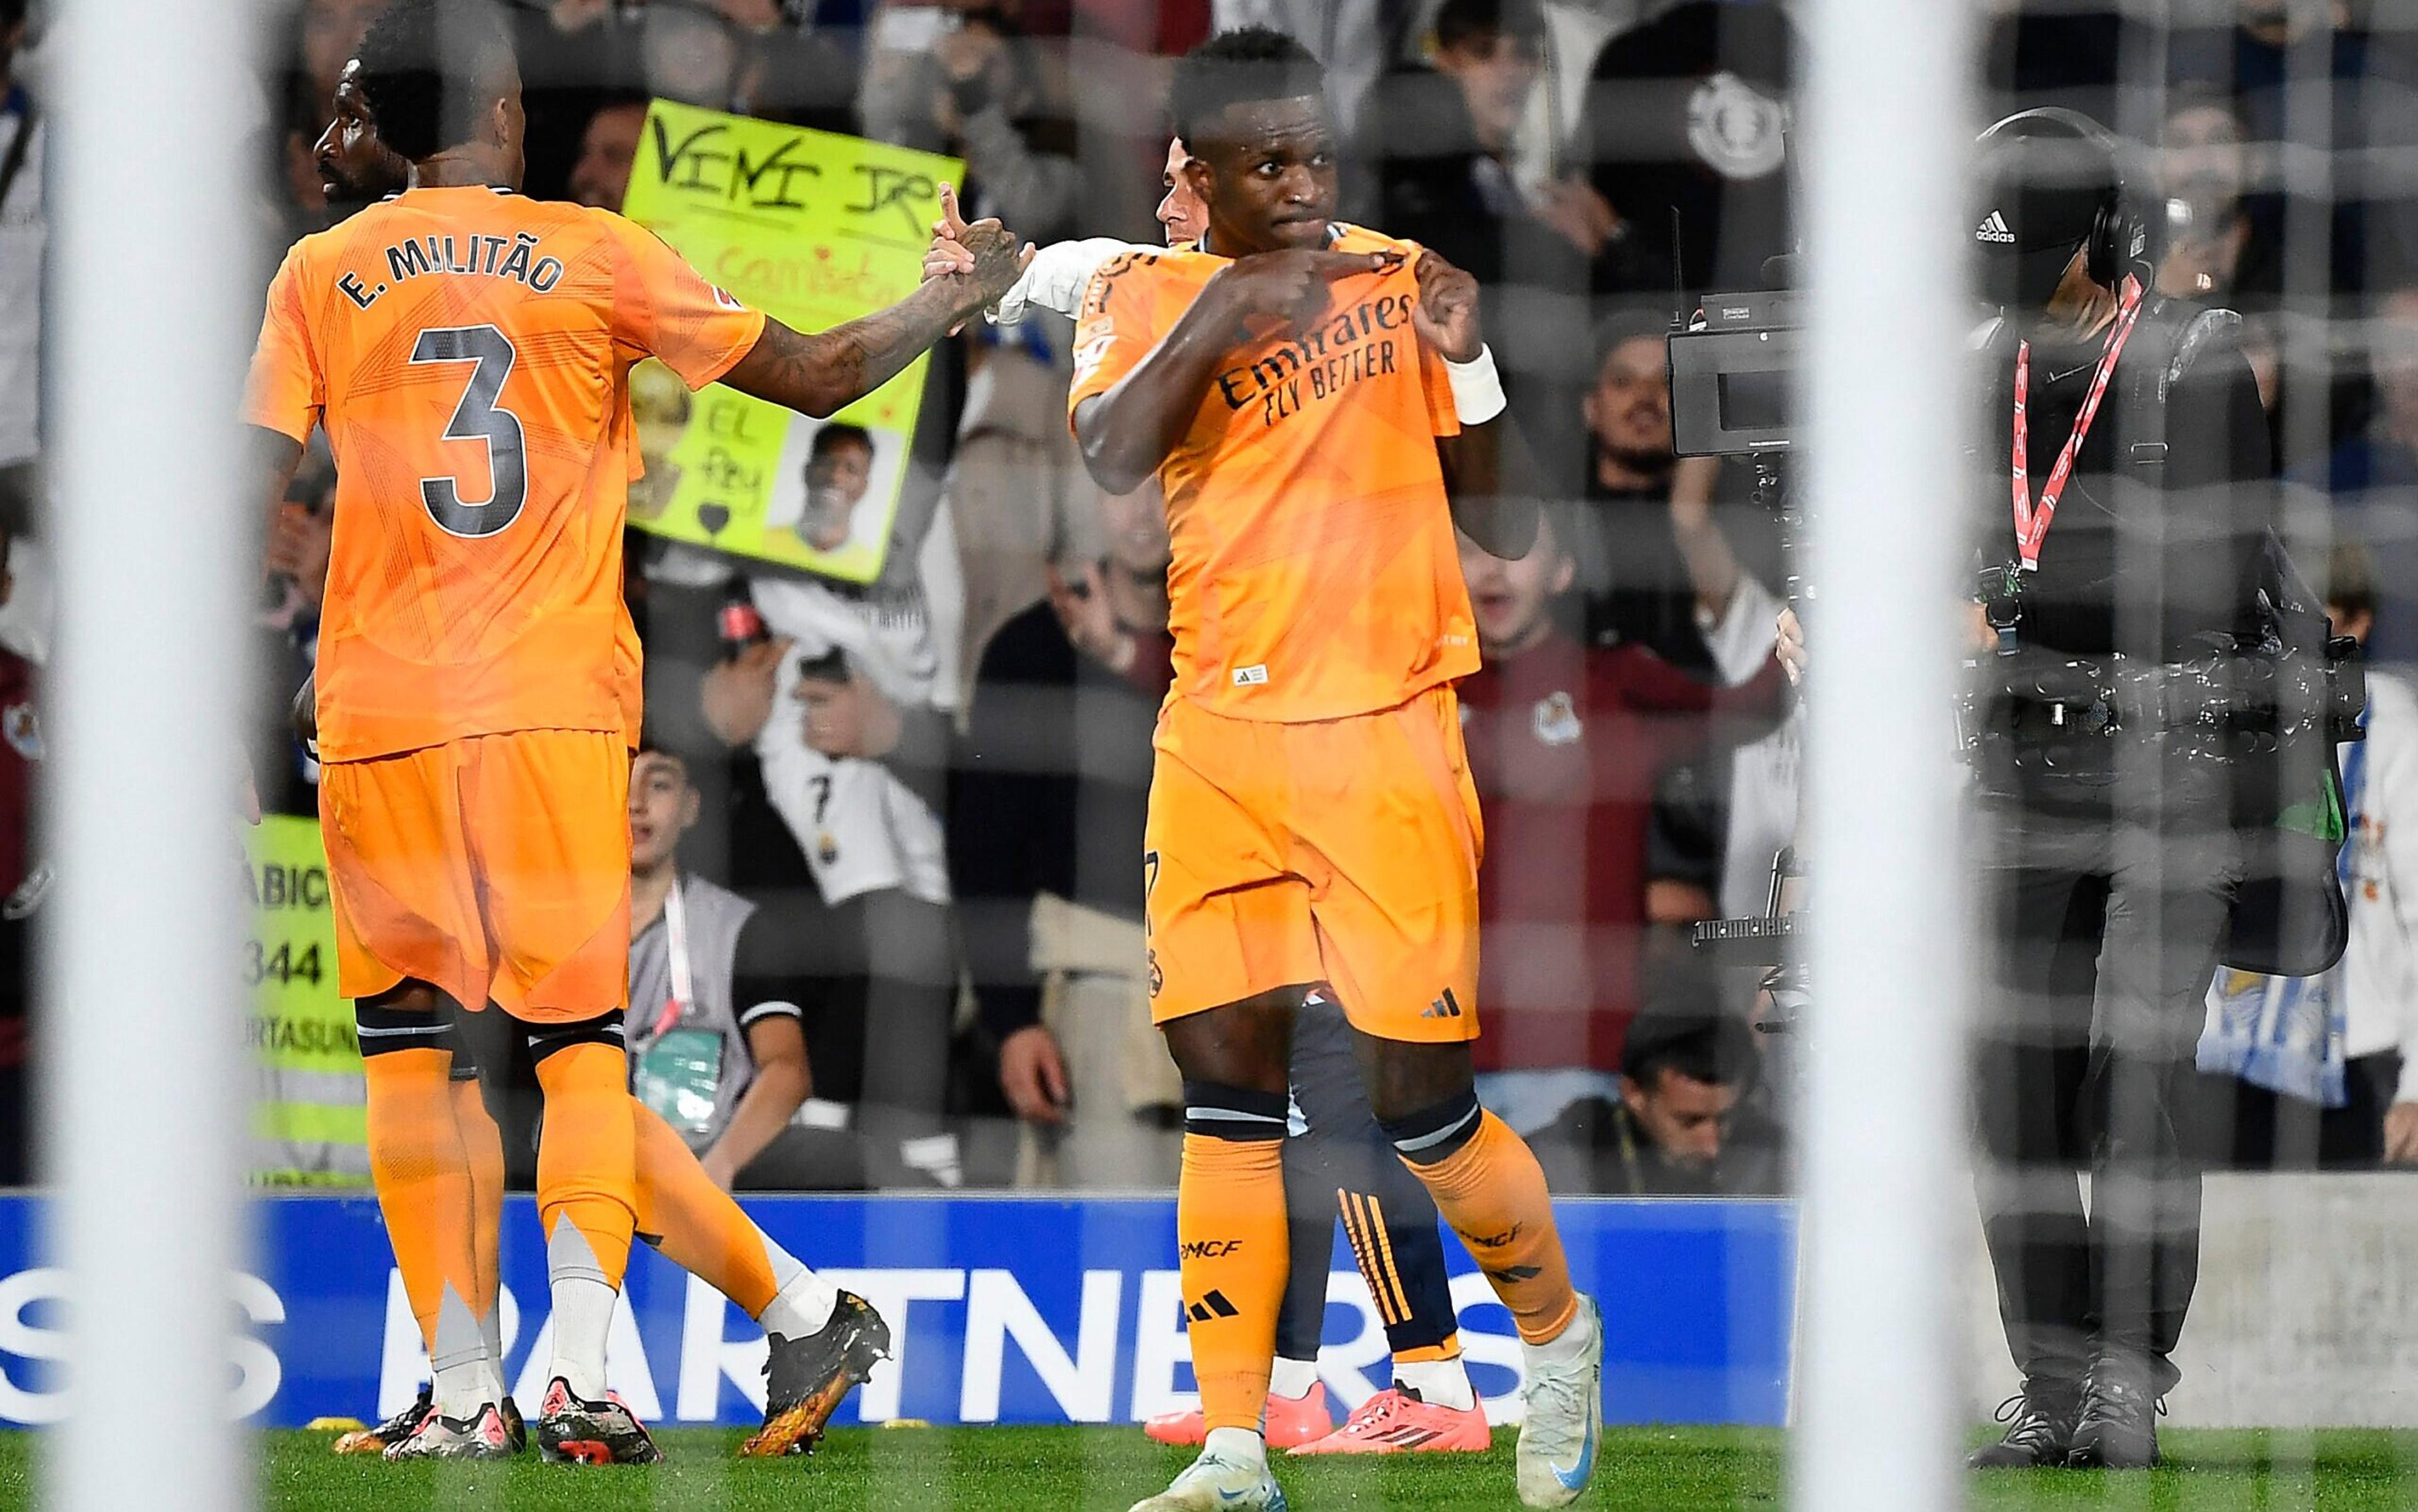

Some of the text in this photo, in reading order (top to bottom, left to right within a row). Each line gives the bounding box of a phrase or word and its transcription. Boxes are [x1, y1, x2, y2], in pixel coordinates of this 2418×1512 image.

[653, 115, 934, 237] VINI JR
[336, 231, 565, 312] E. MILITÃO
[1975, 230, 2016, 243] adidas
[1218, 293, 1414, 411] Emirates
[1264, 339, 1395, 427] FLY BETTER
[407, 322, 528, 540] 3
